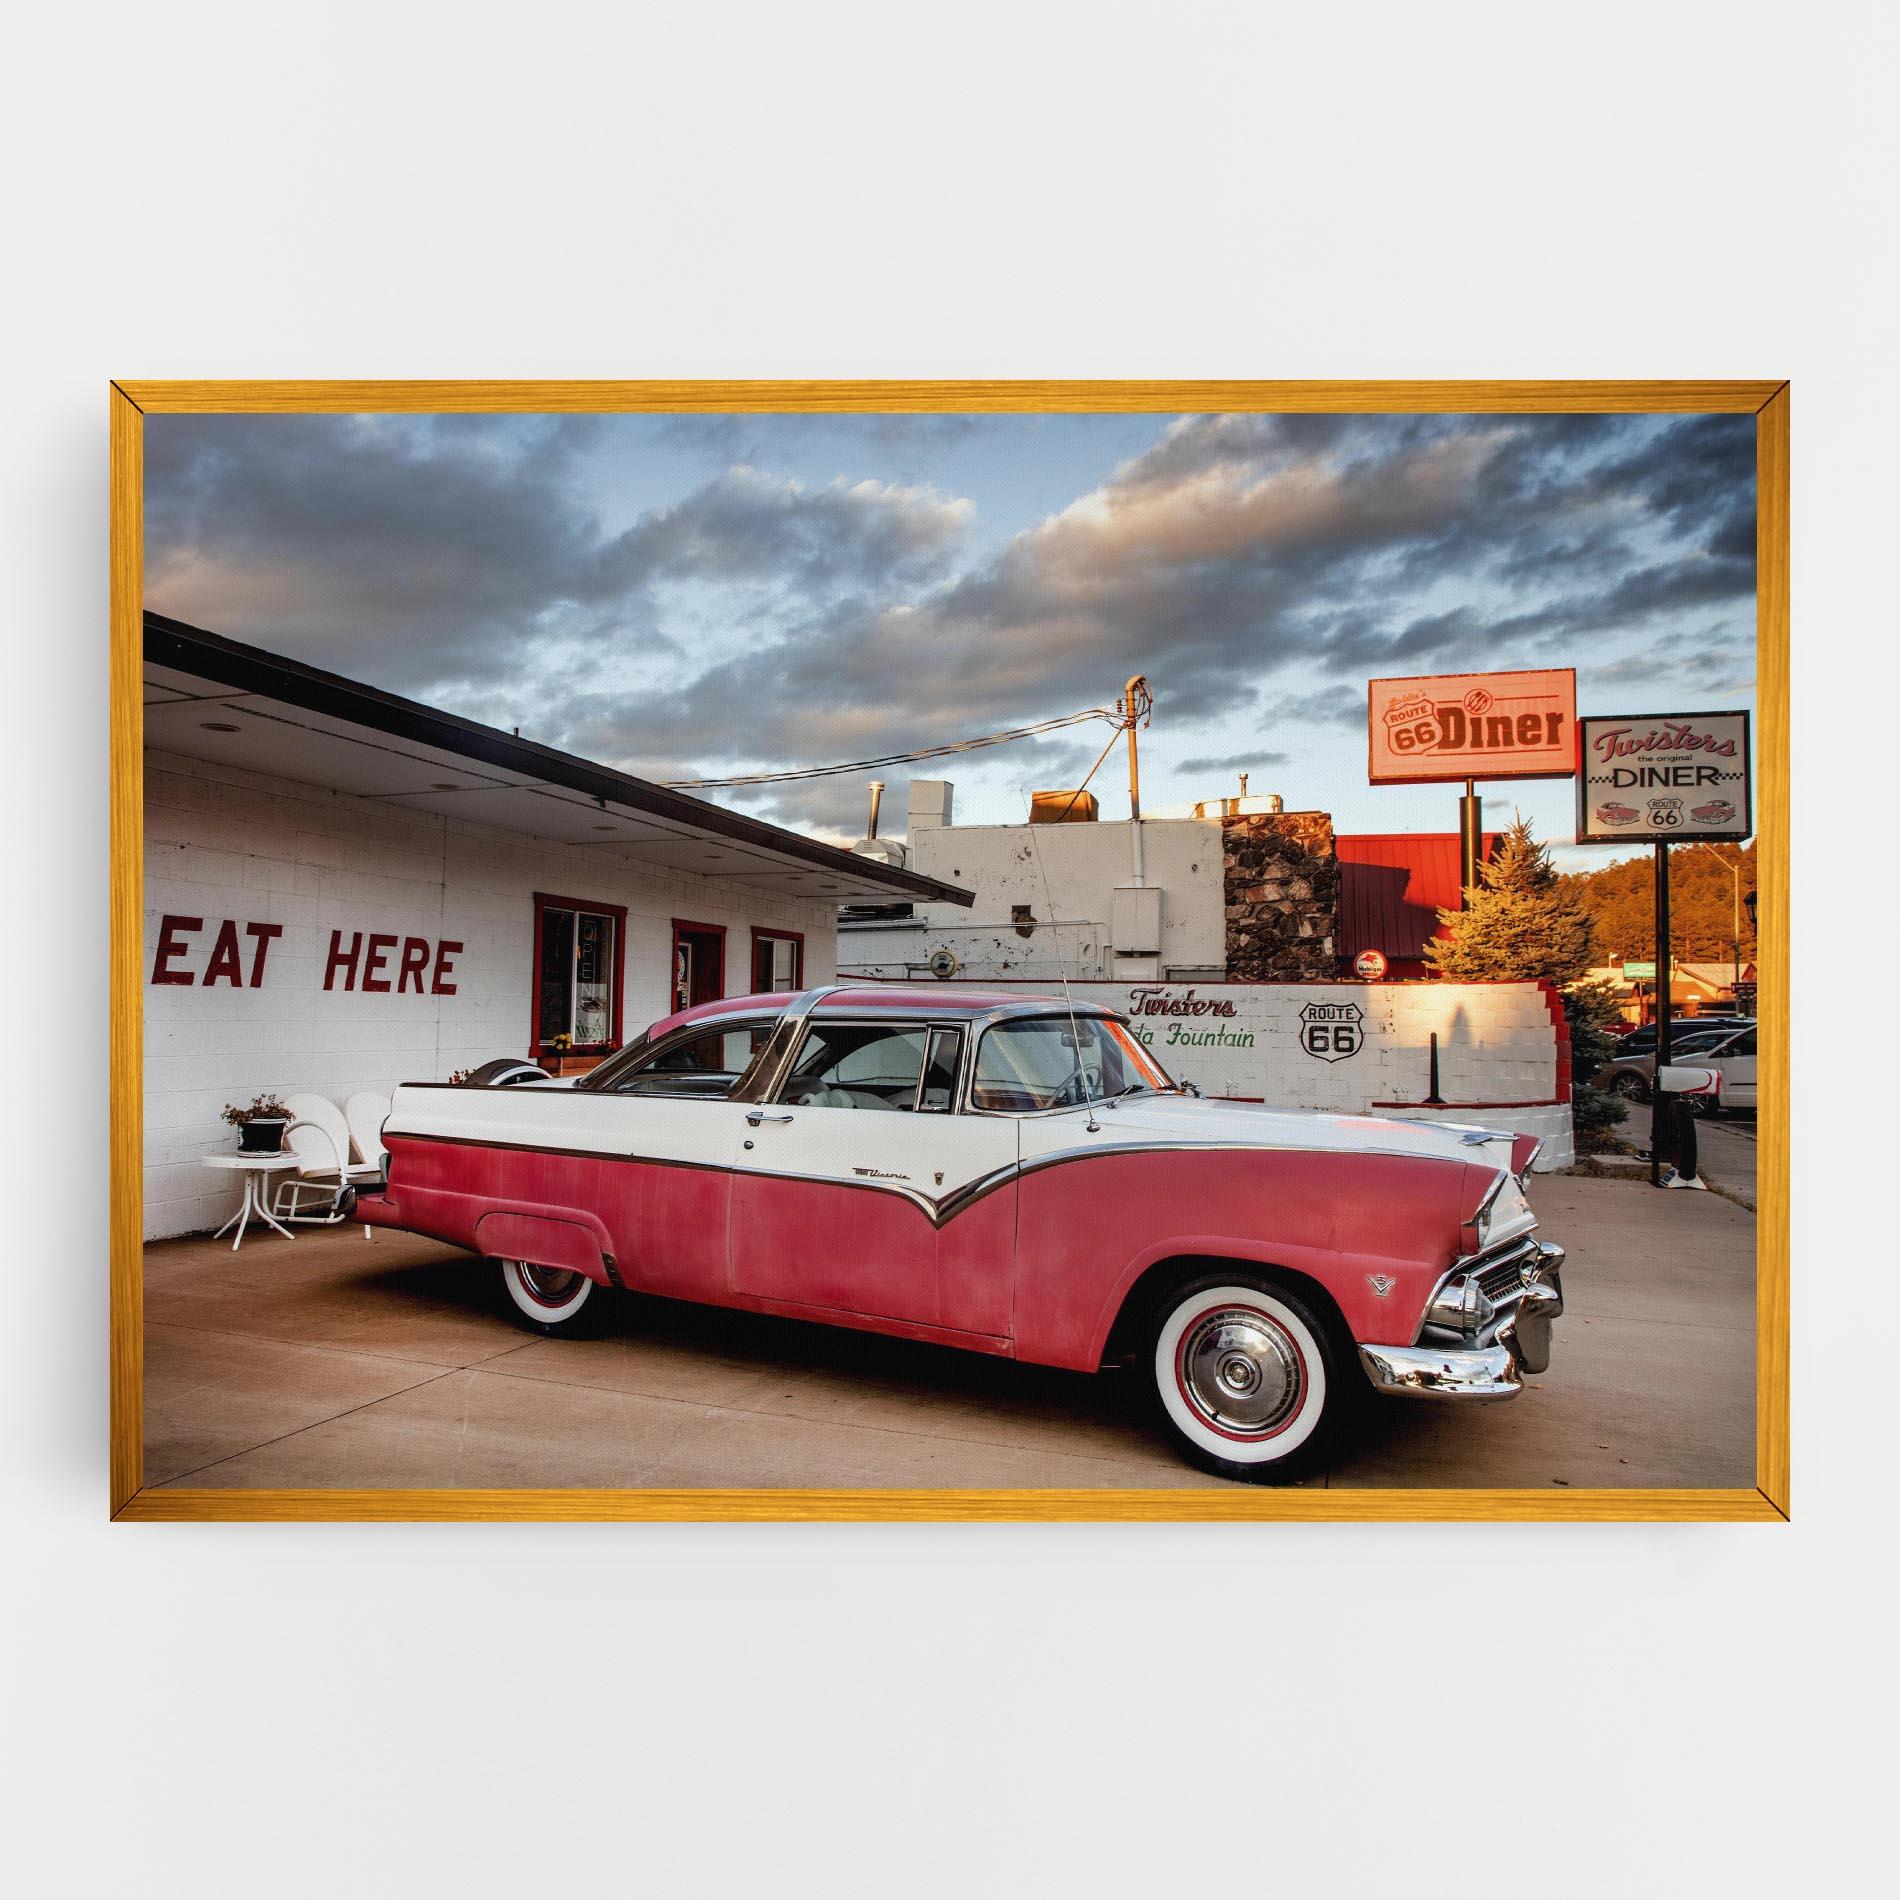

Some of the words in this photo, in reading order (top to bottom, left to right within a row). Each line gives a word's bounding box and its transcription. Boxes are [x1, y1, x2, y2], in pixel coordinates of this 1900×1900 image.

[1390, 705, 1427, 723] ROUTE
[1394, 721, 1436, 750] 66
[1436, 706, 1564, 750] Diner
[1593, 722, 1737, 763] Twisters
[1656, 754, 1693, 763] original
[1613, 765, 1720, 788] DINER
[1652, 800, 1678, 808] ROUTE
[1652, 809, 1678, 825] 66
[151, 914, 283, 988] EAT
[322, 929, 464, 996] HERE
[581, 924, 595, 999] OPEN
[1129, 986, 1238, 1018] Twisters
[1308, 1007, 1354, 1020] ROUTE
[1134, 1022, 1154, 1045] da
[1166, 1022, 1255, 1048] Fountain
[1308, 1025, 1355, 1053] 66
